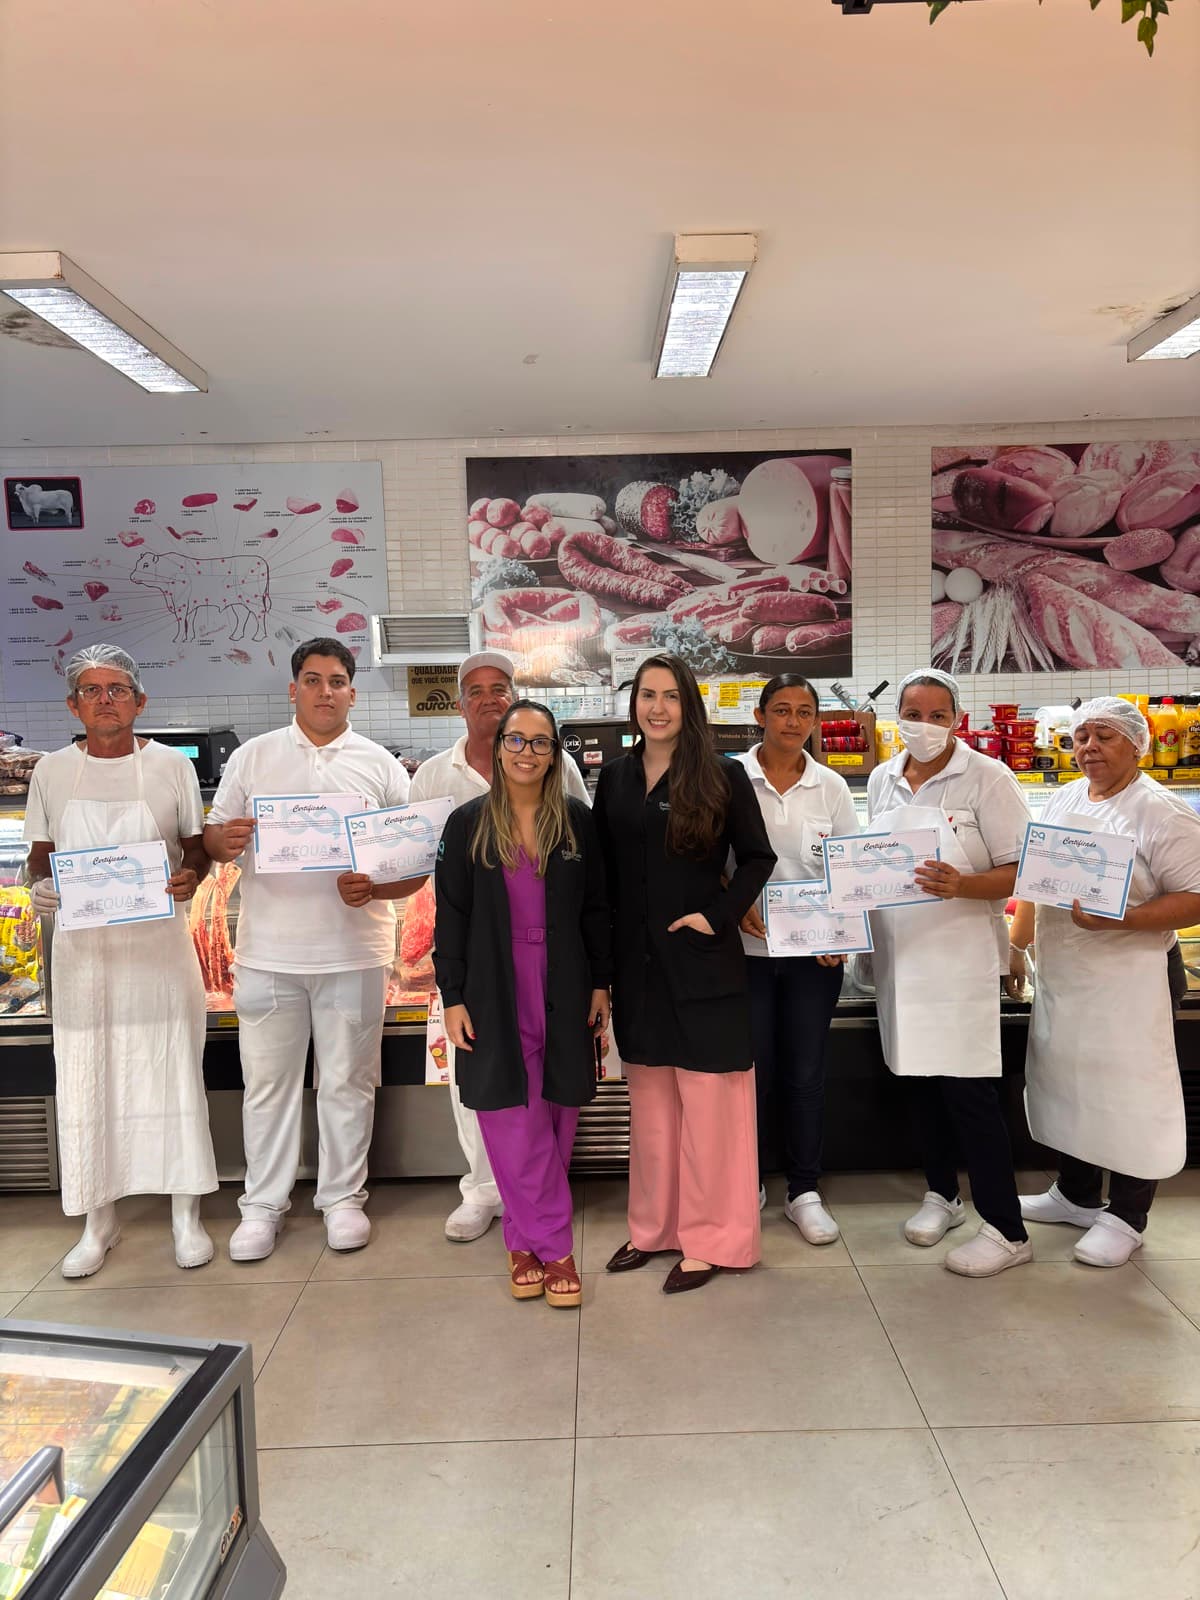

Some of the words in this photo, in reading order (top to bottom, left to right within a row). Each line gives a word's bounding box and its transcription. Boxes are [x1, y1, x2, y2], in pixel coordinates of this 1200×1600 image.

[414, 665, 458, 675] QUALIDADE
[441, 676, 458, 684] CONFI
[416, 701, 458, 711] aurora
[565, 739, 580, 748] prix
[292, 804, 327, 813] Certificado
[384, 813, 418, 826] Certificado
[863, 840, 899, 851] Certificado
[1062, 836, 1097, 848] Certificado
[92, 854, 128, 866] Certificado
[798, 888, 827, 898] Certificad
